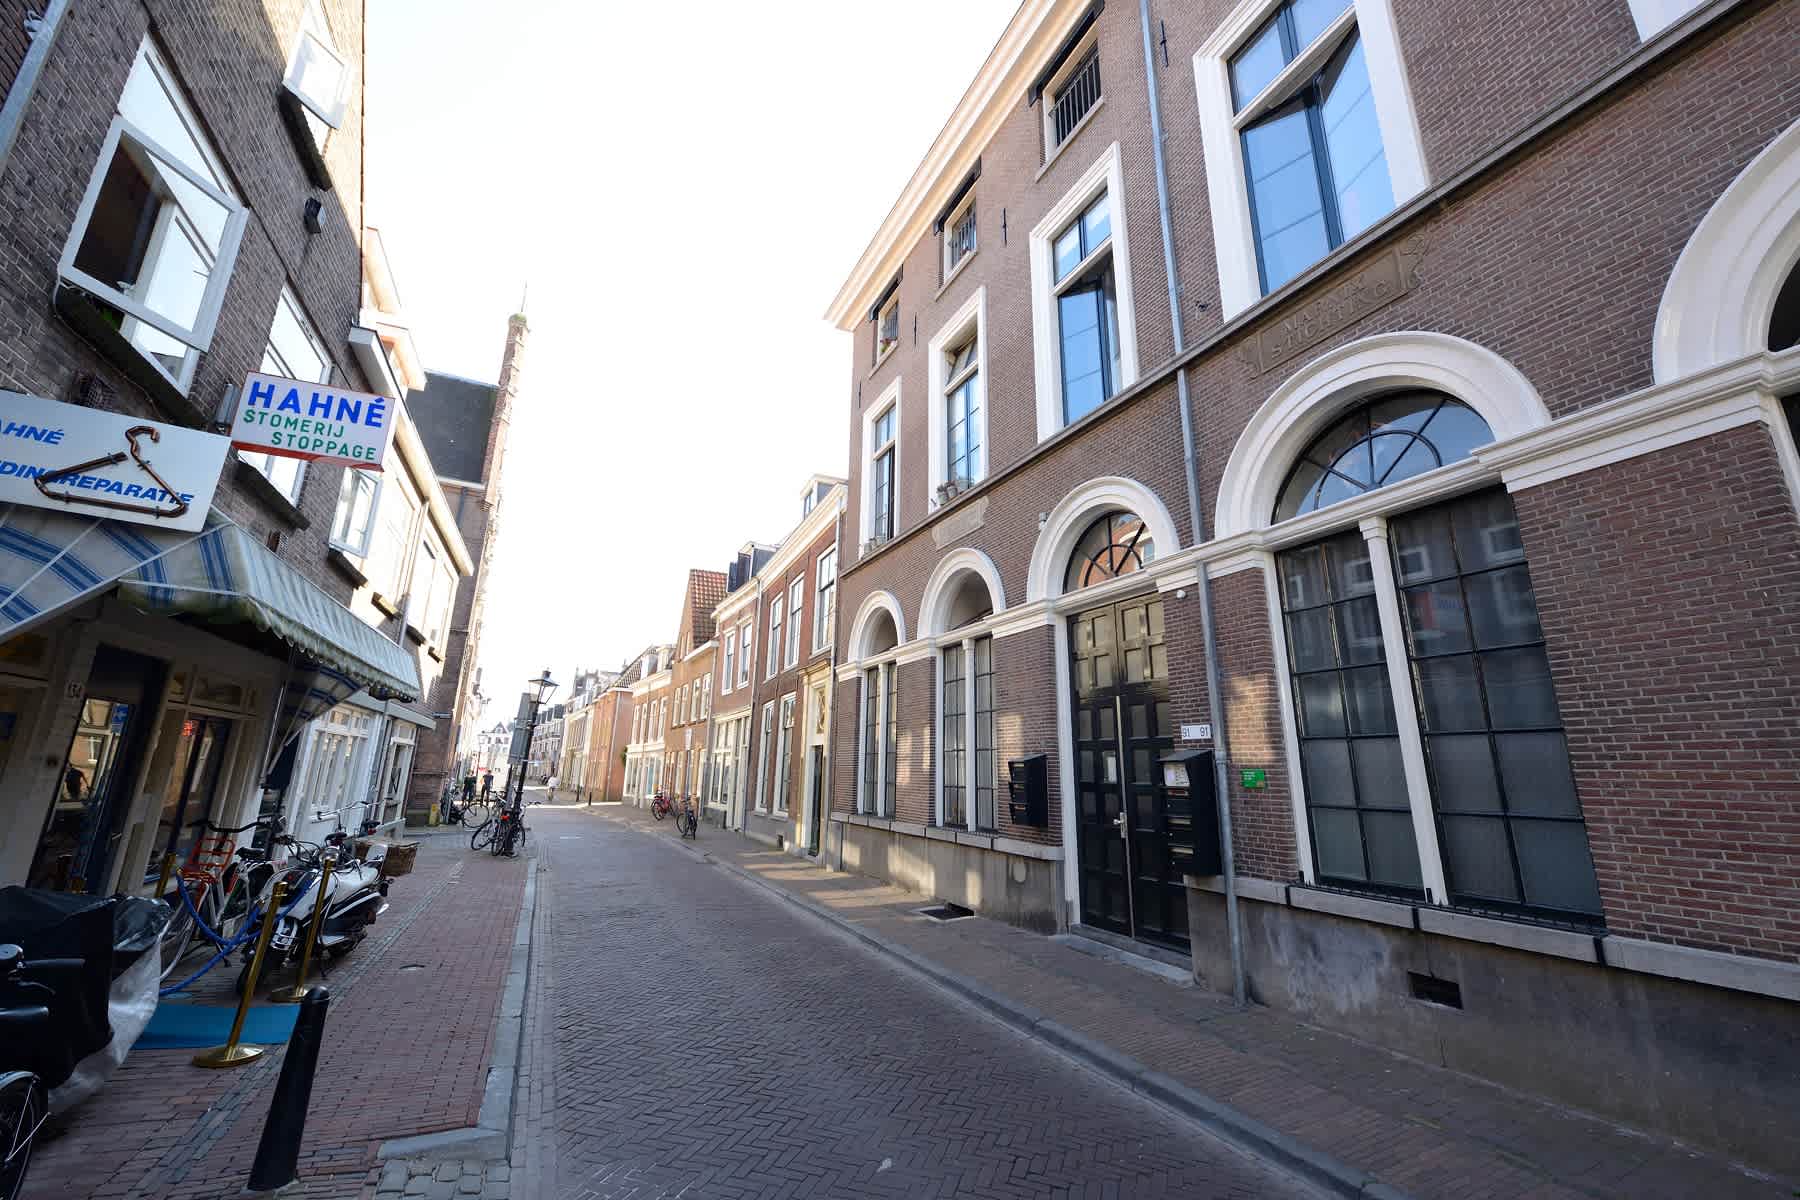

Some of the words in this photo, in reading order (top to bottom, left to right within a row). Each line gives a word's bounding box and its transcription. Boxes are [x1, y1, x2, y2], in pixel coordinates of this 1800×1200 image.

[248, 381, 386, 428] HAHNÉ
[0, 418, 65, 445] HNÉ
[243, 409, 345, 438] STOMERIJ
[271, 432, 377, 460] STOPPAGE
[0, 460, 194, 506] DINREPARATIE
[1200, 726, 1209, 737] 91
